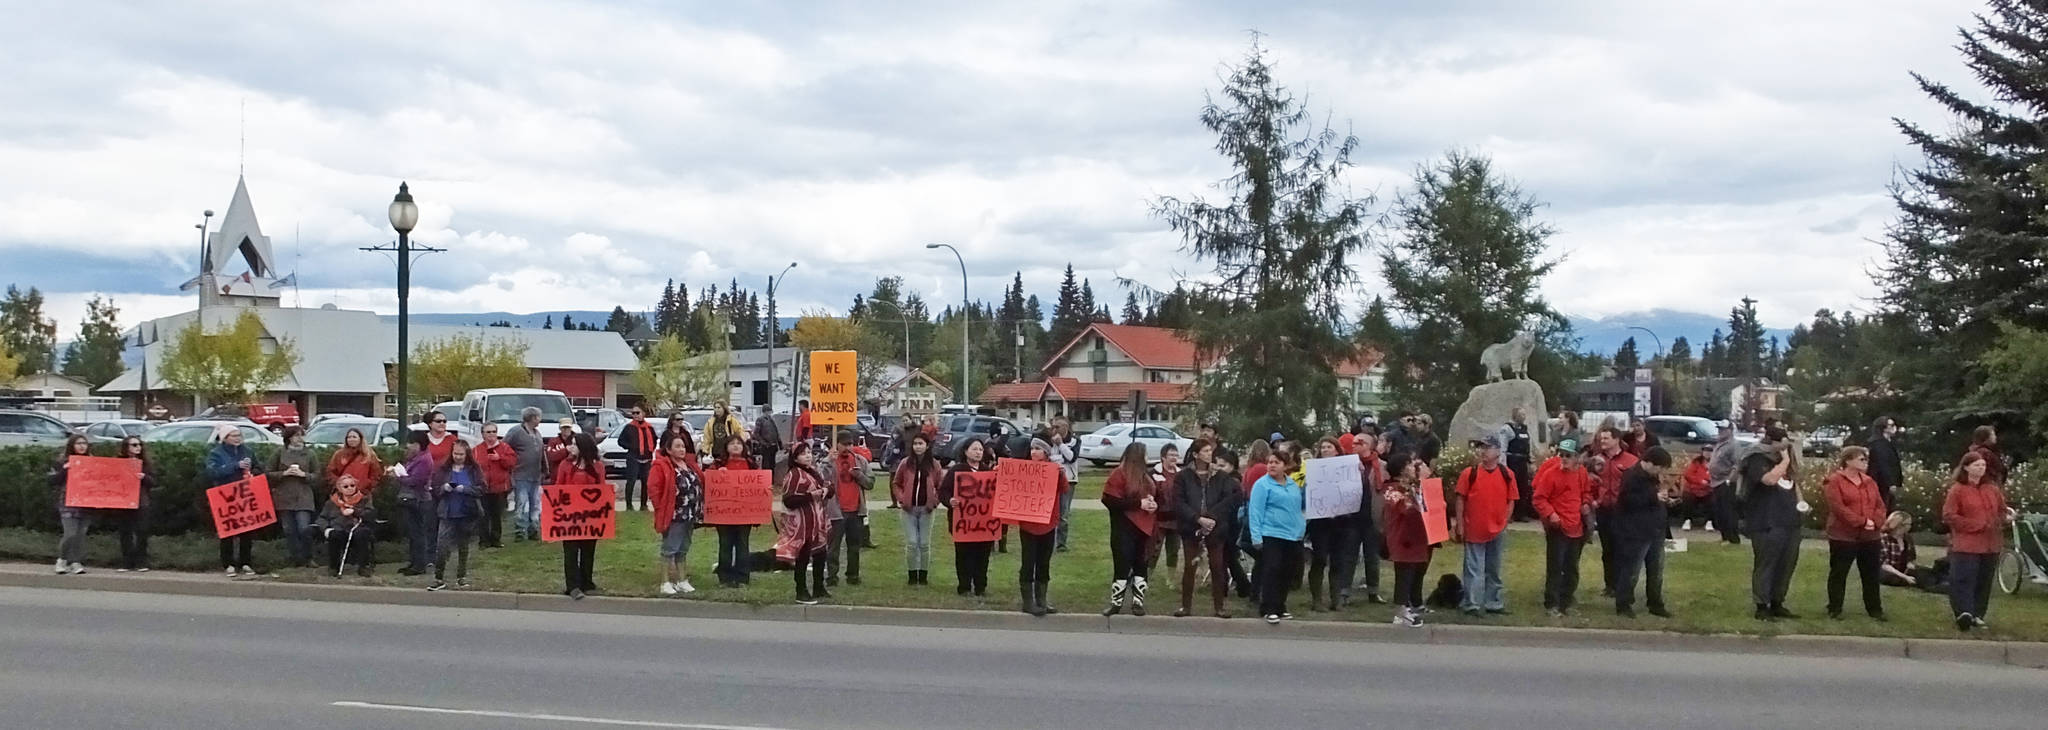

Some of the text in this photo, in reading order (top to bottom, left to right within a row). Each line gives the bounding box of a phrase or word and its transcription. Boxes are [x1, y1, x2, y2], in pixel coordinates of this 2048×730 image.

[825, 363, 840, 374] WE
[819, 383, 845, 393] WANT
[811, 402, 854, 413] ANSWERS
[901, 400, 934, 409] INN
[1001, 462, 1048, 479] NO MORE
[711, 474, 763, 484] WE LOVE
[1001, 479, 1045, 494] STOLEN
[219, 480, 254, 502] WE
[543, 489, 571, 507] We
[710, 486, 769, 498] YOU JESSICA
[218, 498, 258, 518] LOVE
[959, 499, 989, 518] YOU
[999, 495, 1053, 513] SISTERS
[553, 501, 612, 524] Support
[222, 511, 272, 531] JESSICA
[956, 519, 986, 534] ALL
